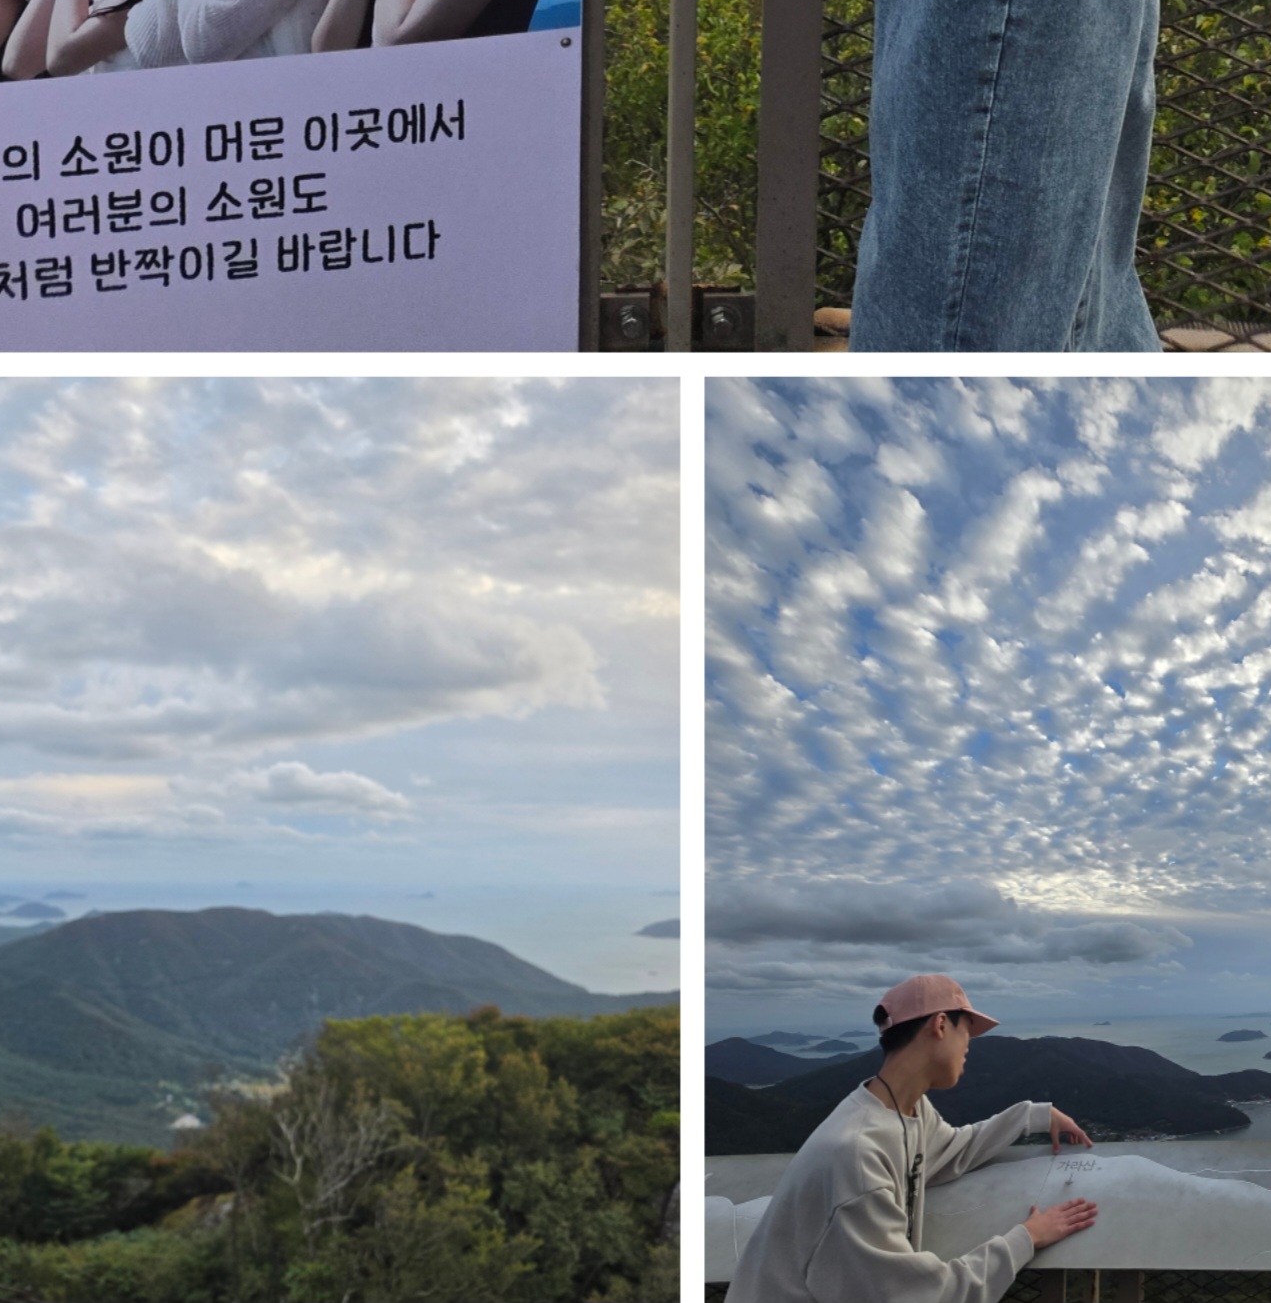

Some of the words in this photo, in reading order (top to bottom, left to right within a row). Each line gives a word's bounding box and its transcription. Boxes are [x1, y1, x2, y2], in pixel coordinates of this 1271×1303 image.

[59, 127, 185, 177] 소원이
[205, 116, 285, 163] 머문
[303, 98, 465, 153] 이곳에서
[16, 185, 187, 239] 여러분의
[205, 172, 328, 223] 소원도
[90, 237, 259, 293] 반짝이길
[277, 219, 442, 273] 바랍니다
